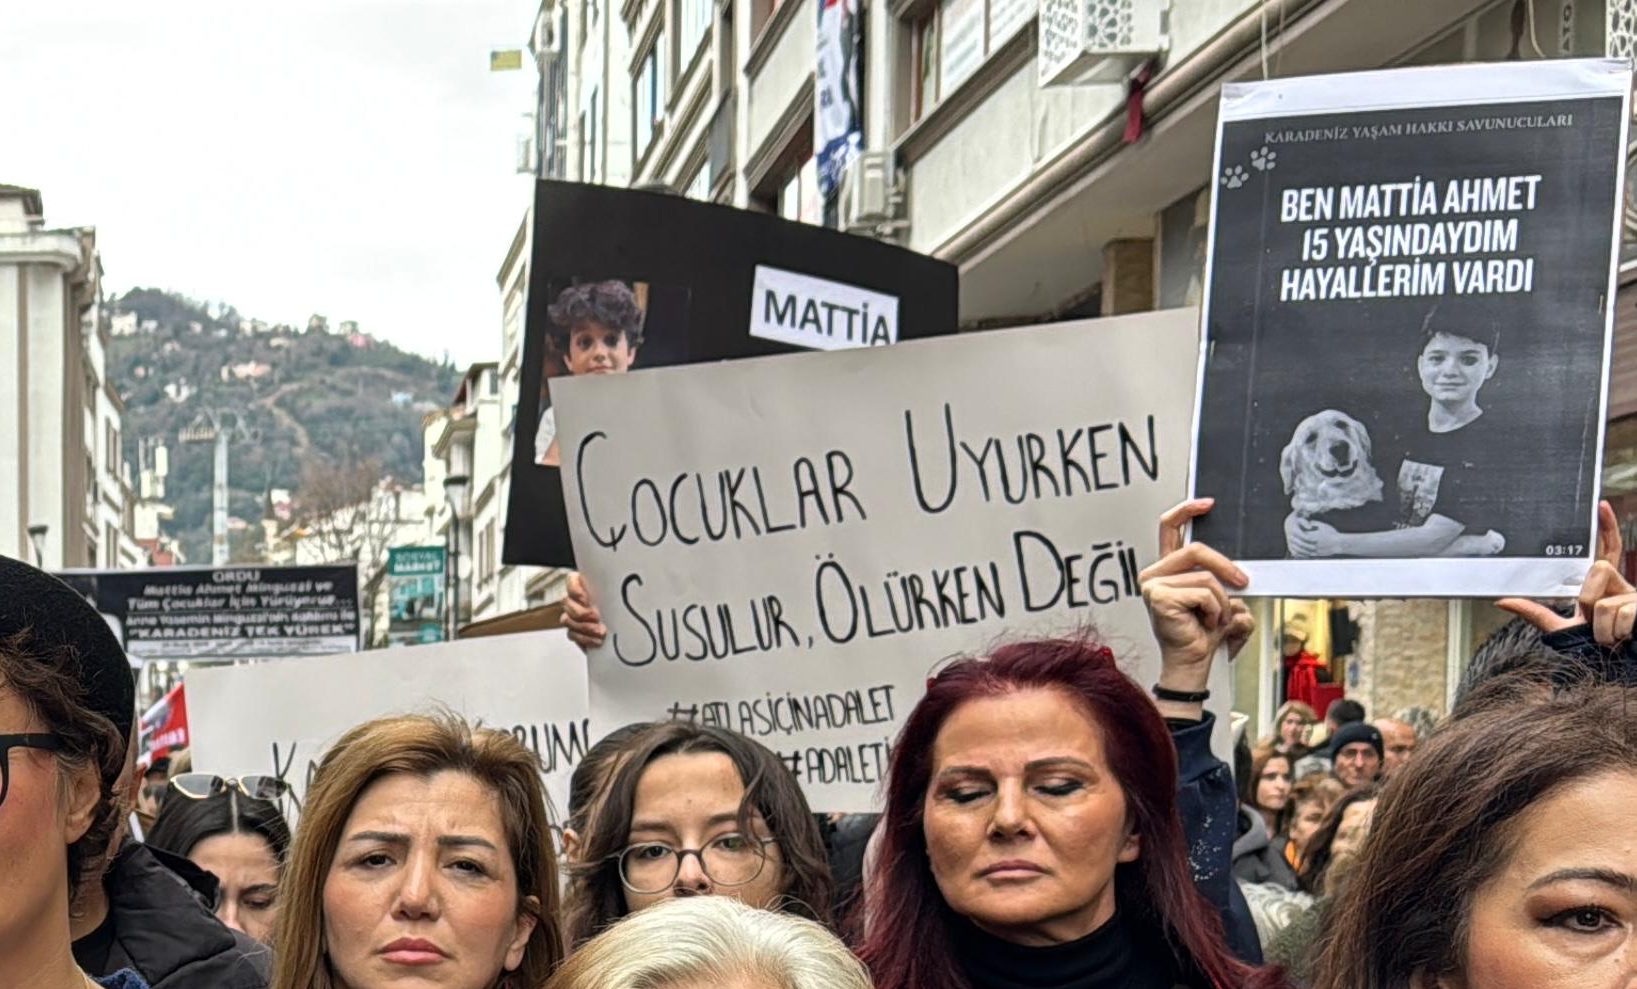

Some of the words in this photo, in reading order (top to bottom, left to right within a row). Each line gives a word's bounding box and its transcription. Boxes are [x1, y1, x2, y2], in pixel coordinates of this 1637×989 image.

[1264, 126, 1349, 144] KARADENİZ
[1352, 124, 1403, 141] YAŞAM
[1405, 120, 1454, 136] HAKKI
[1457, 114, 1574, 133] SAVUNUCULARI
[1280, 187, 1335, 223] BEN
[1339, 175, 1438, 220] MATTİA
[1442, 174, 1543, 215] AHMET
[1301, 228, 1330, 262] 15
[1333, 219, 1519, 266] YAŞINDAYDIM
[1279, 257, 1447, 302] HAYALLERİM
[1452, 258, 1535, 296] VARDI
[763, 288, 892, 346] MATTİA
[575, 430, 868, 553] ÇOCUKLAR
[904, 401, 1159, 514] UYURKEN
[1544, 544, 1584, 556] 03:17
[211, 570, 261, 583] ORDU
[315, 581, 334, 593] ve
[128, 597, 160, 610] Tüm
[612, 573, 814, 667] SUSULUR,
[814, 552, 1007, 645] ÖLÜRKEN
